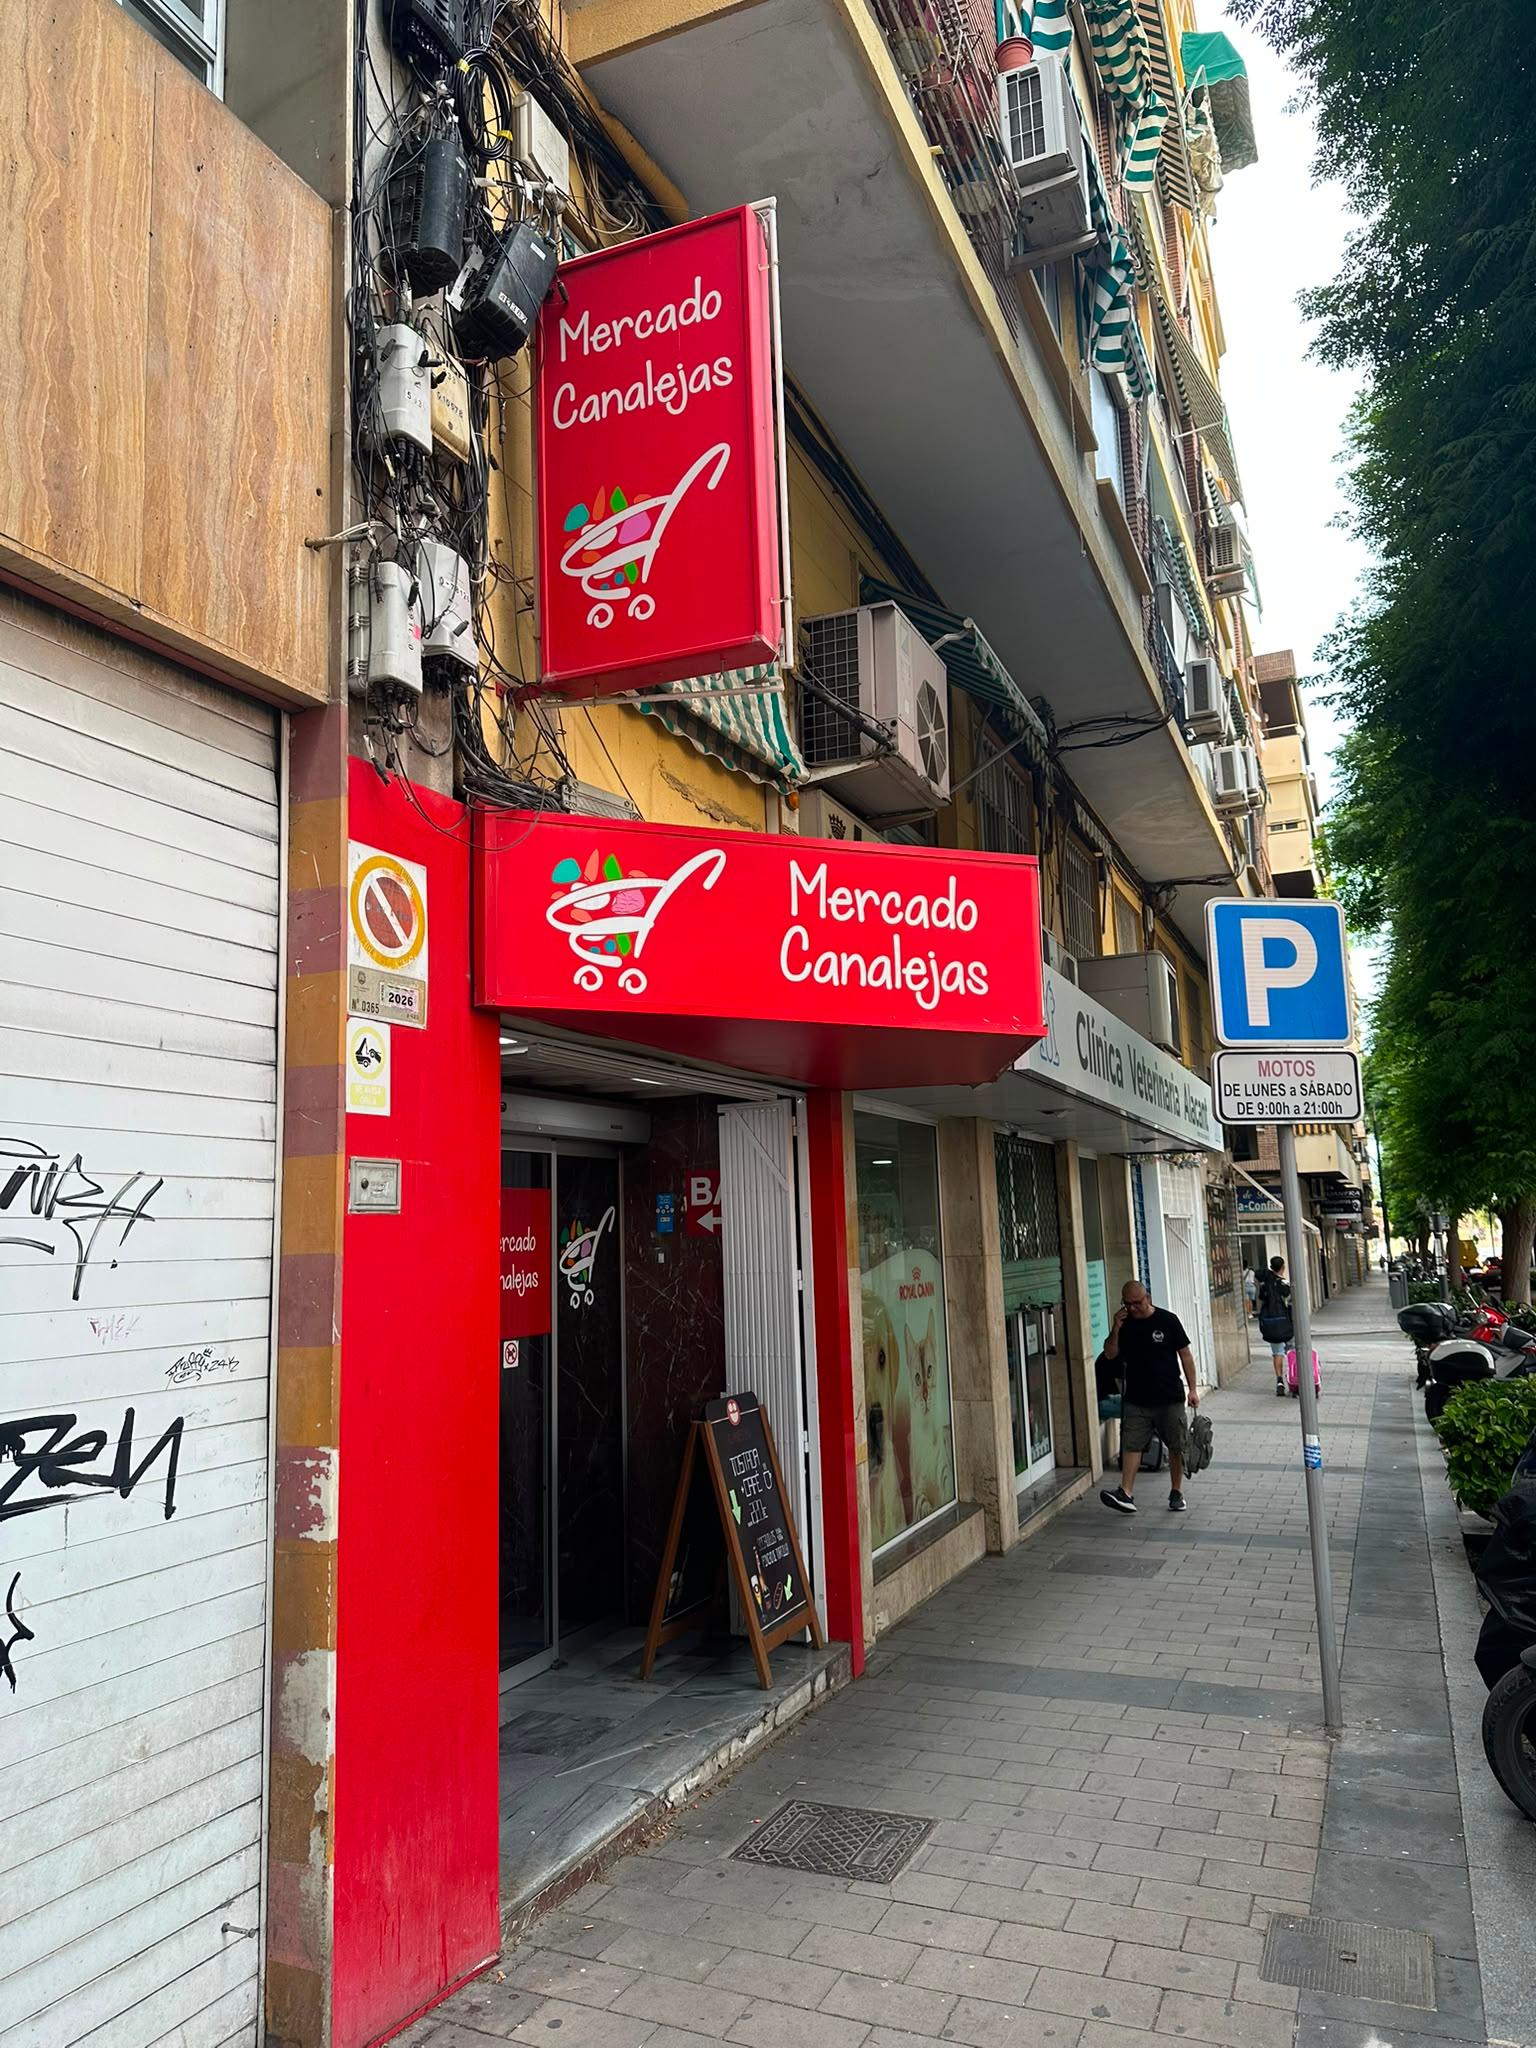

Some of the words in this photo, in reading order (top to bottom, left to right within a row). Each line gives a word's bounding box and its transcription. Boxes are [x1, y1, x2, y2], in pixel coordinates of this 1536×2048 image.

[559, 275, 722, 363] Mercado
[553, 356, 733, 430] Canalejas
[789, 859, 979, 931] Mercado
[780, 925, 989, 1010] Canalejas
[1240, 917, 1319, 1027] P
[361, 1000, 380, 1014] 0365
[388, 992, 414, 1007] 2026
[1076, 1010, 1124, 1089] Clínica
[1127, 1043, 1181, 1117] Veterinaria
[1258, 1060, 1316, 1077] MOTOS
[1224, 1083, 1241, 1097] DE
[1244, 1083, 1286, 1096] LUNES
[1289, 1086, 1297, 1096] a
[1300, 1080, 1353, 1096] SÁBADO
[1237, 1102, 1254, 1115] DE
[1258, 1101, 1290, 1115] 9:00h
[1293, 1104, 1301, 1115] a
[1304, 1101, 1343, 1115] 21:00h
[899, 1283, 918, 1300] ROYAL
